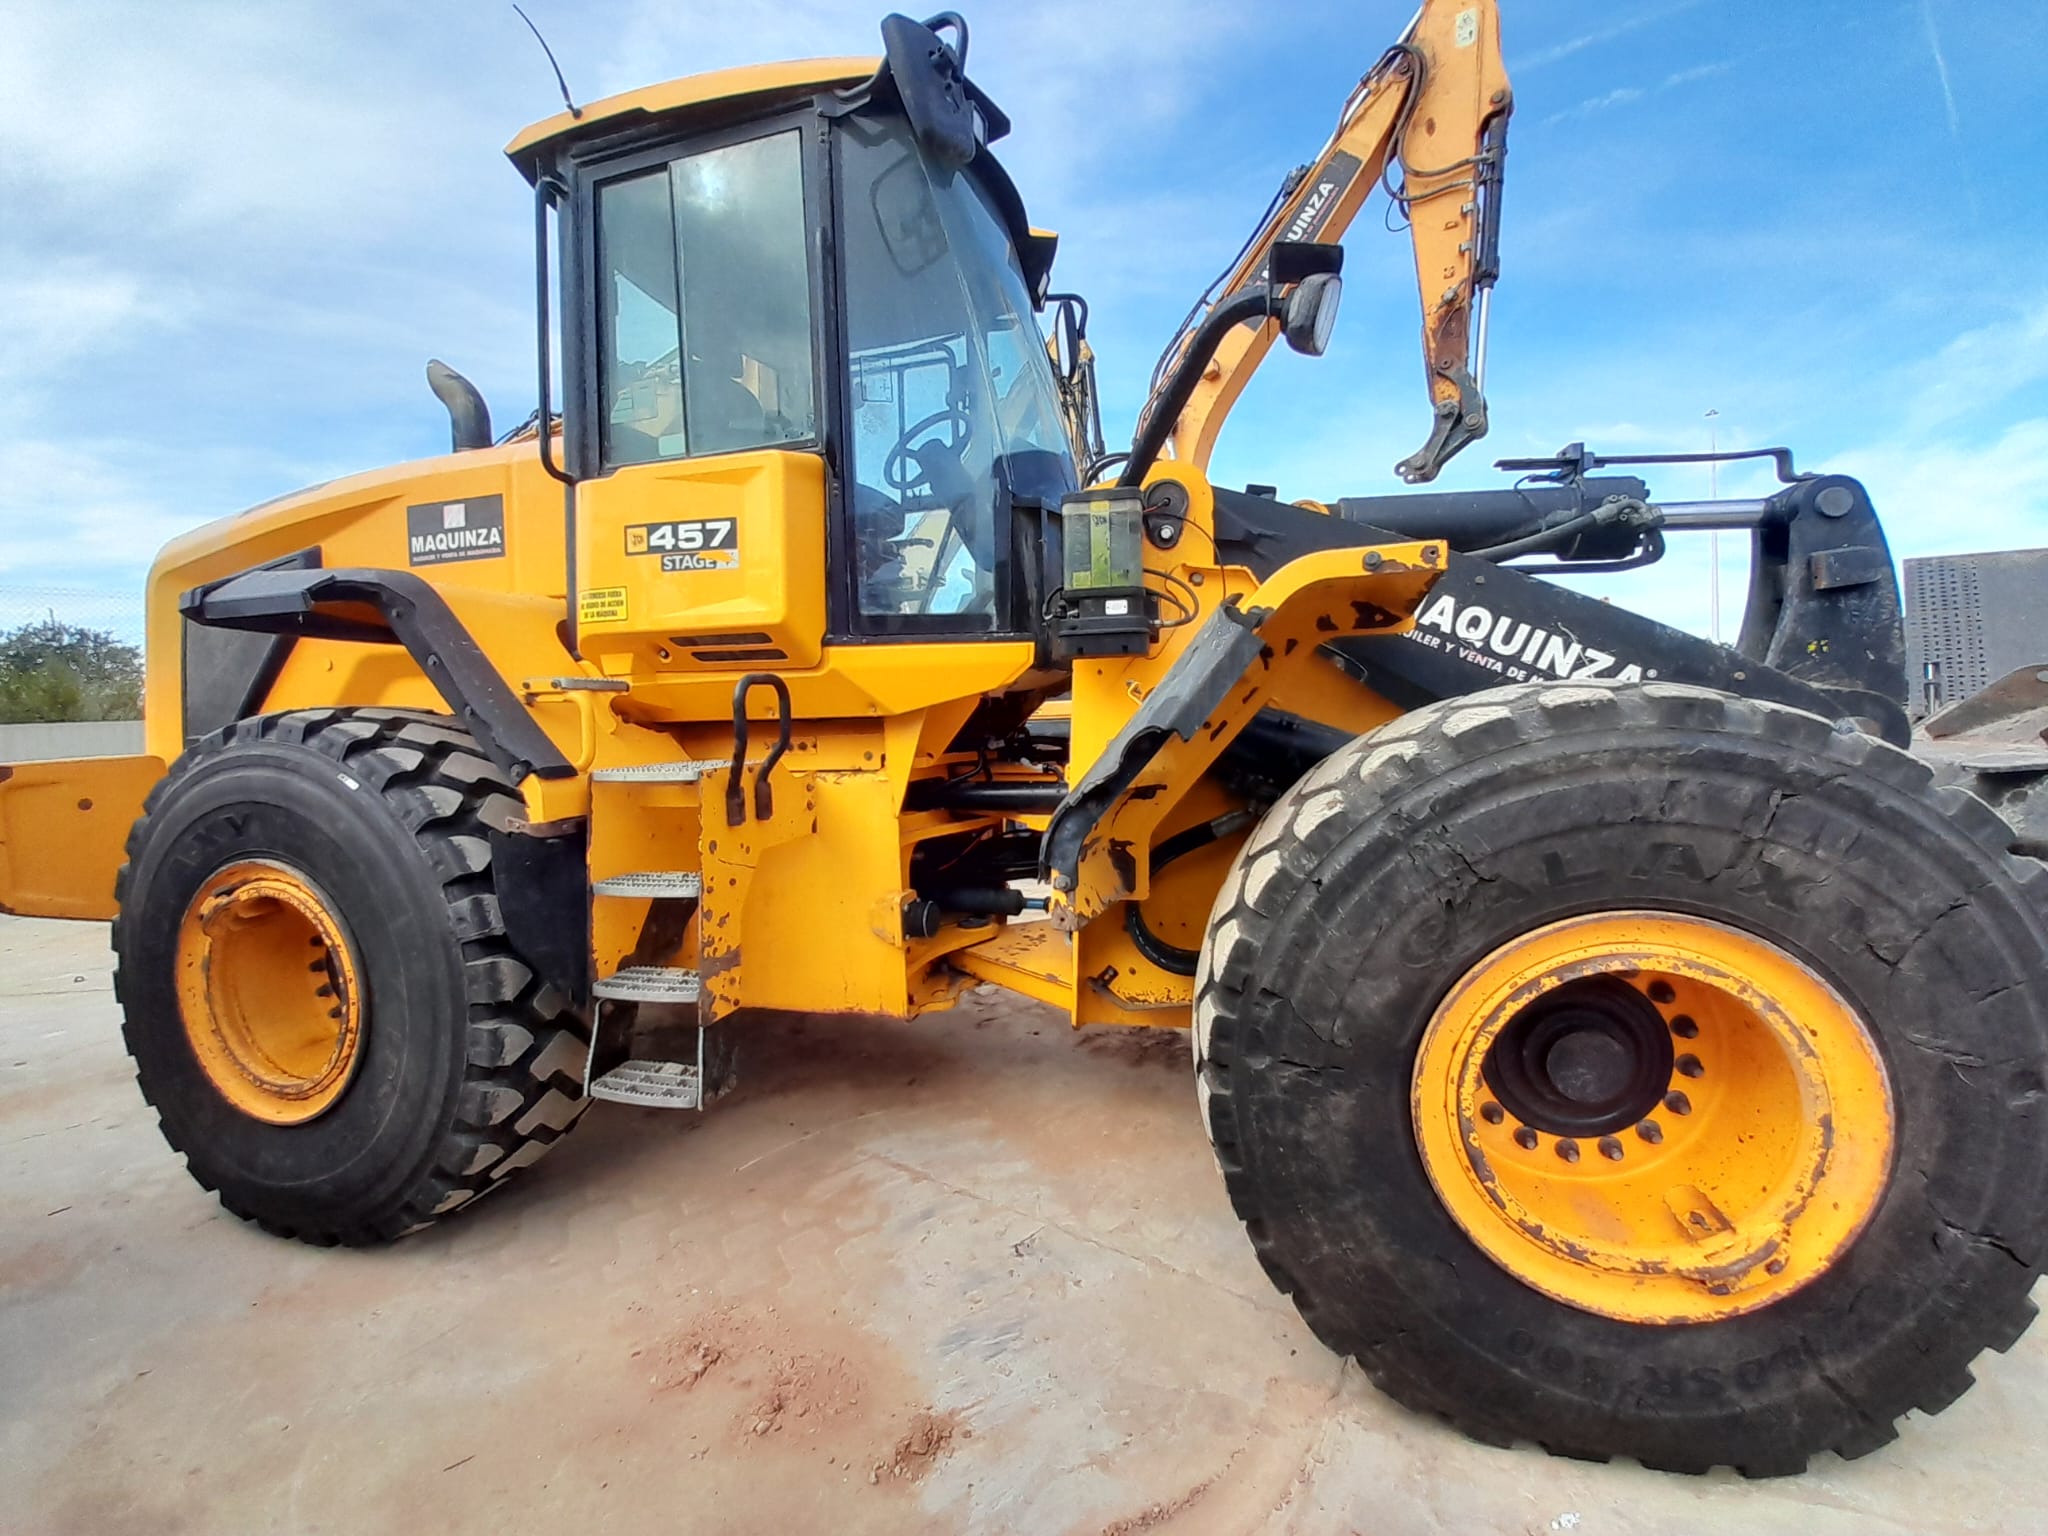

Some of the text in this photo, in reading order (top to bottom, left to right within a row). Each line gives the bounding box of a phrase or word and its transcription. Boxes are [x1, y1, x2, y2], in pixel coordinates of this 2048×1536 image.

[411, 527, 501, 553] MAQUINZA
[649, 521, 731, 550] 457
[663, 554, 715, 570] STAGE
[1414, 595, 1642, 683] AQUINZA
[1445, 641, 1457, 654] Y
[1459, 647, 1503, 673] VENTA
[1506, 666, 1528, 682] DE
